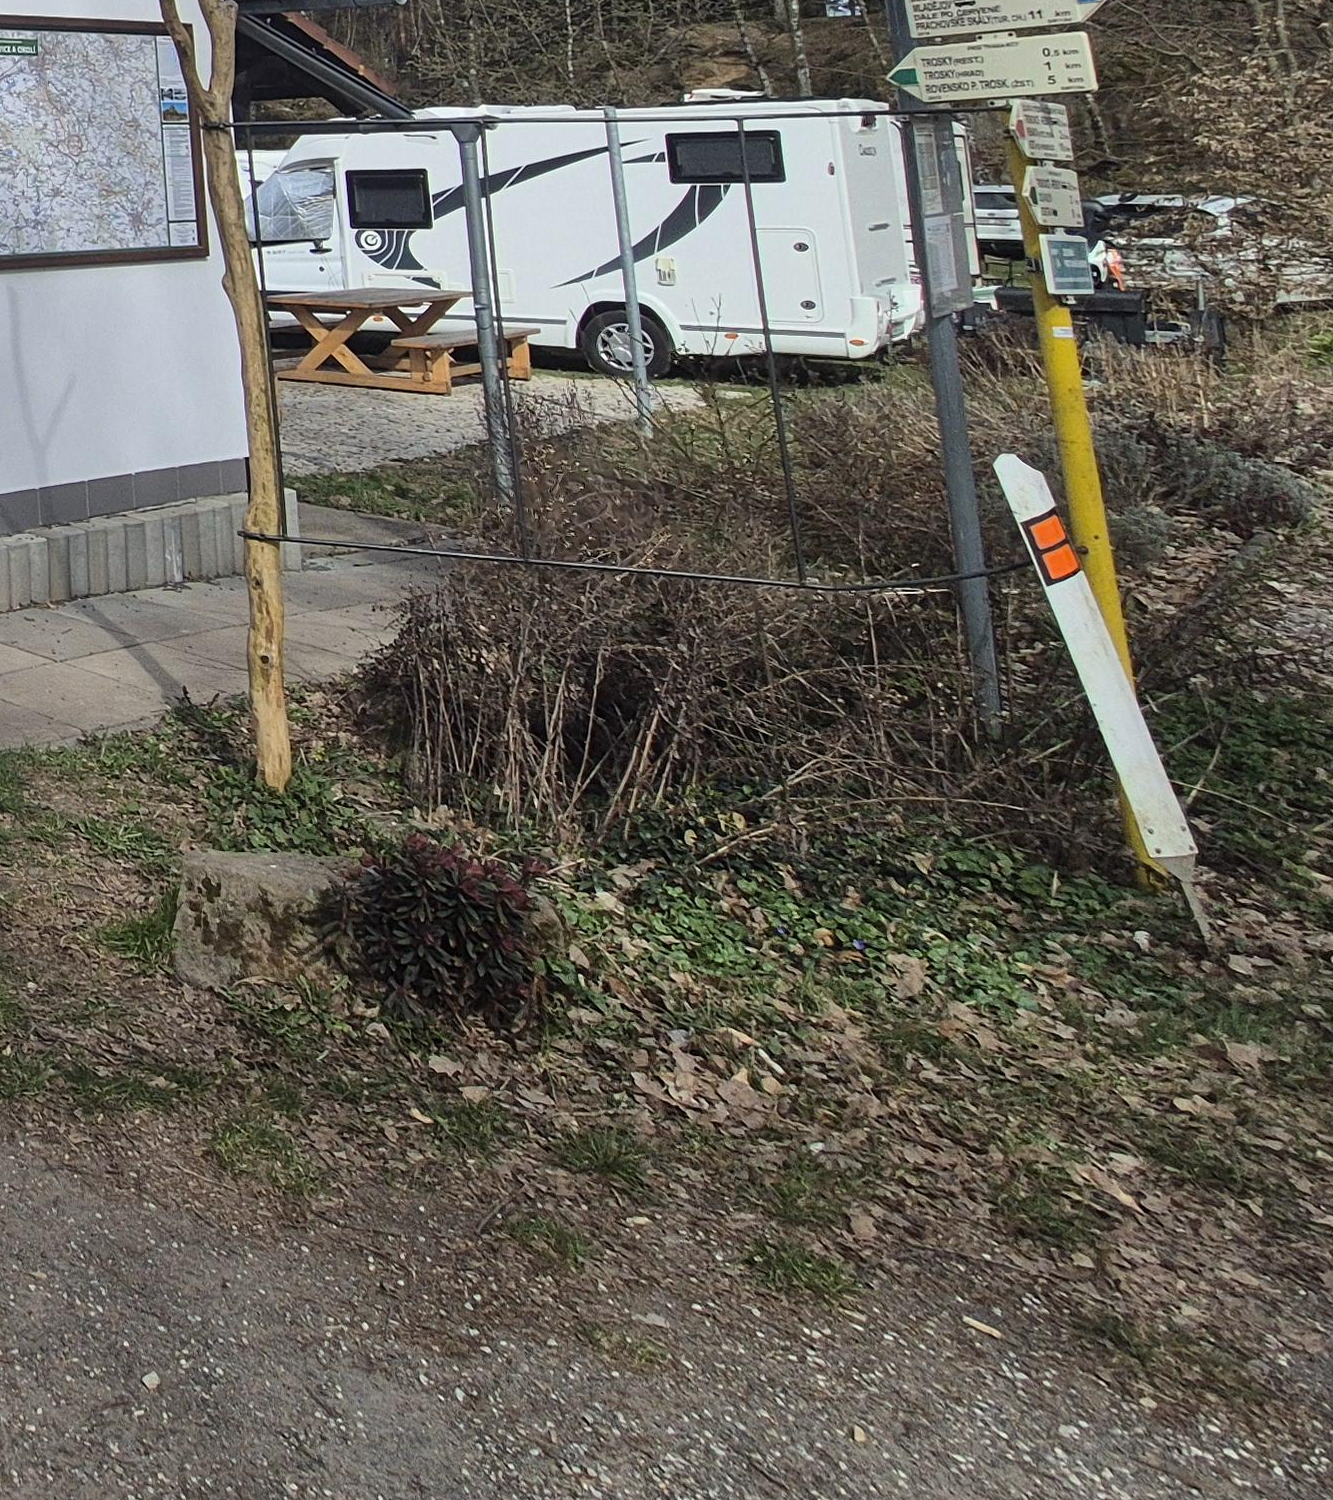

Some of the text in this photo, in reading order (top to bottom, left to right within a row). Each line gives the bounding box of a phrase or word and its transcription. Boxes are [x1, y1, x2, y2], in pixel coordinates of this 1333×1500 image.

[1029, 9, 1042, 19] 11
[921, 56, 952, 67] TROSKY
[923, 69, 955, 80] TROSKY
[1044, 62, 1052, 71] 1
[925, 81, 969, 93] ROVENSKO
[1048, 75, 1056, 85] 5
